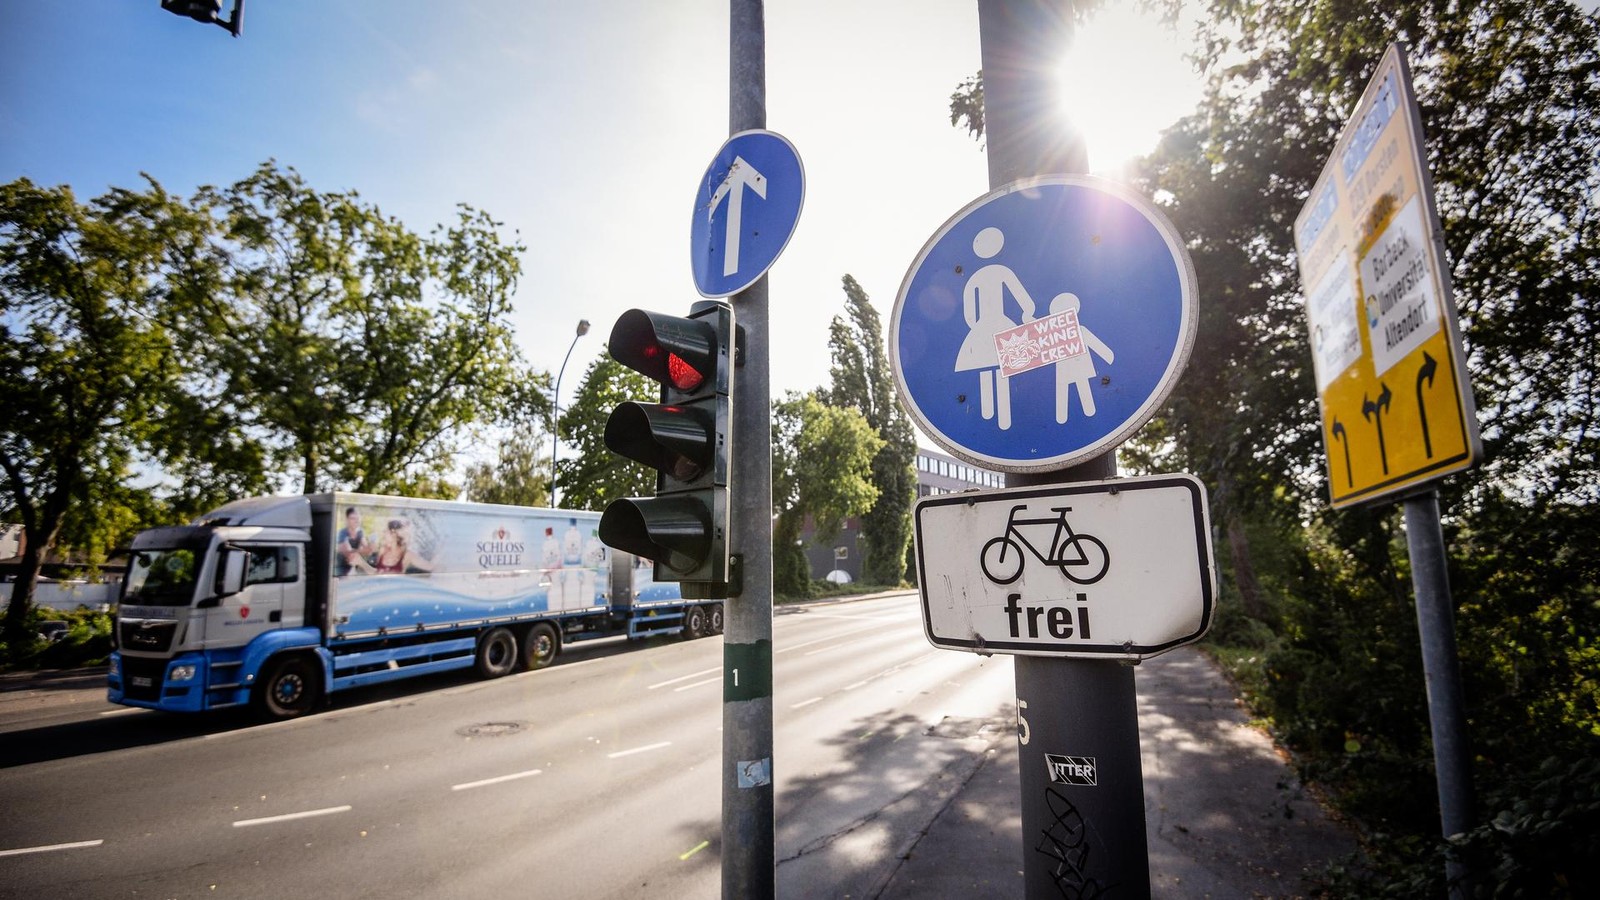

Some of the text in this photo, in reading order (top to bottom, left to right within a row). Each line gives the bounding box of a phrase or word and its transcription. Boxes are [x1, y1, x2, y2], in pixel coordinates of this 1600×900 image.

[1372, 226, 1409, 282] Borbeck
[1378, 248, 1429, 316] Universität
[1034, 312, 1075, 334] WREC
[1384, 294, 1428, 352] Altendorf
[1039, 326, 1078, 348] KING
[1040, 342, 1080, 363] CREW
[476, 541, 525, 553] SCHLOSS
[479, 554, 521, 569] QUELLE
[1004, 593, 1091, 640] frei
[732, 668, 738, 686] 1
[1053, 763, 1092, 776] ITTER
